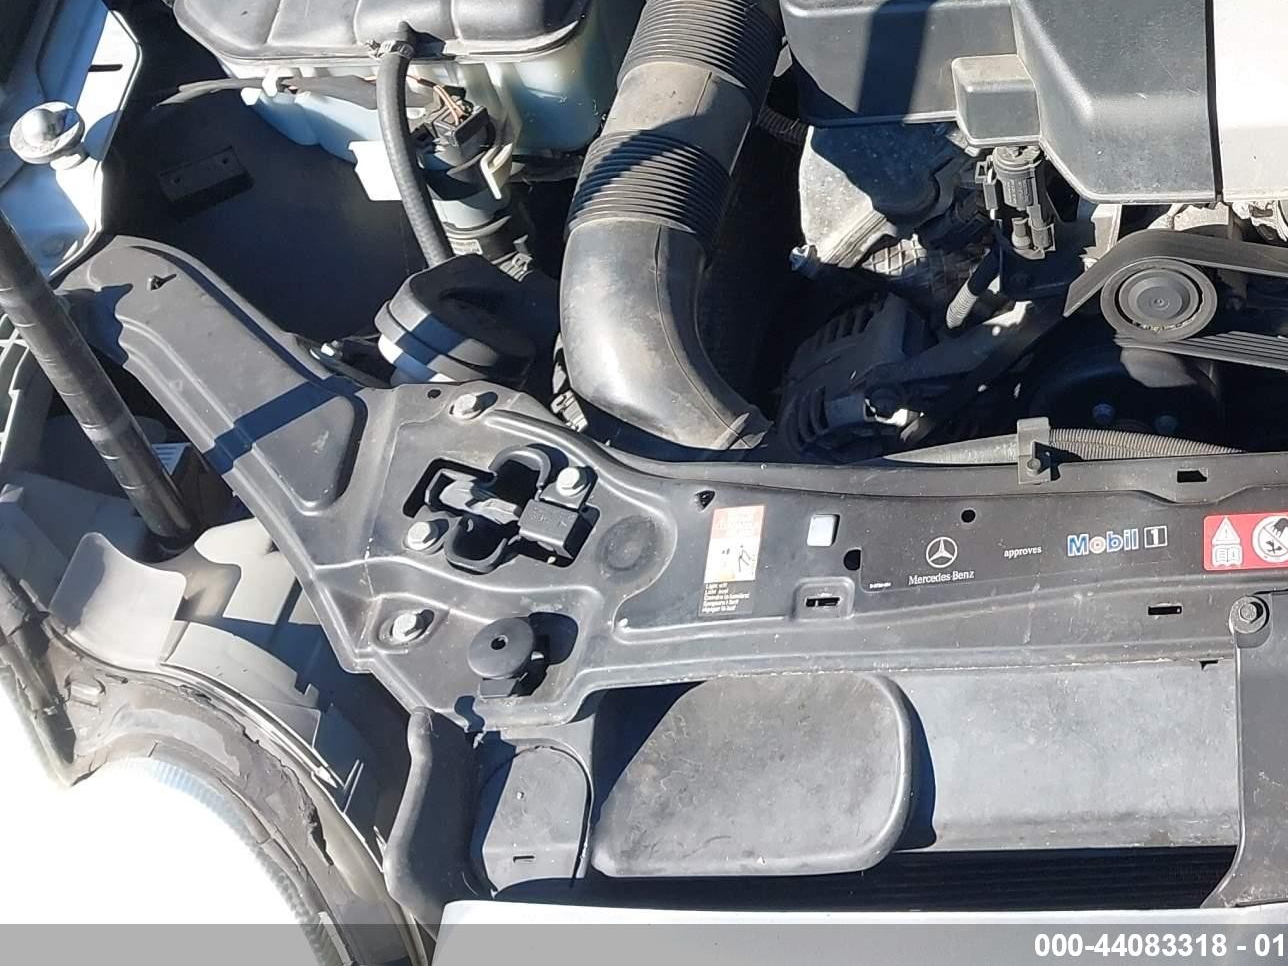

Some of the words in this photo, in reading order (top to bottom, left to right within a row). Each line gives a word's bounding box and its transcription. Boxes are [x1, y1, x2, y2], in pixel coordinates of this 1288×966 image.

[1067, 528, 1139, 557] Mobil
[1004, 546, 1042, 559] approves
[908, 570, 974, 586] Mercedes-Benz
